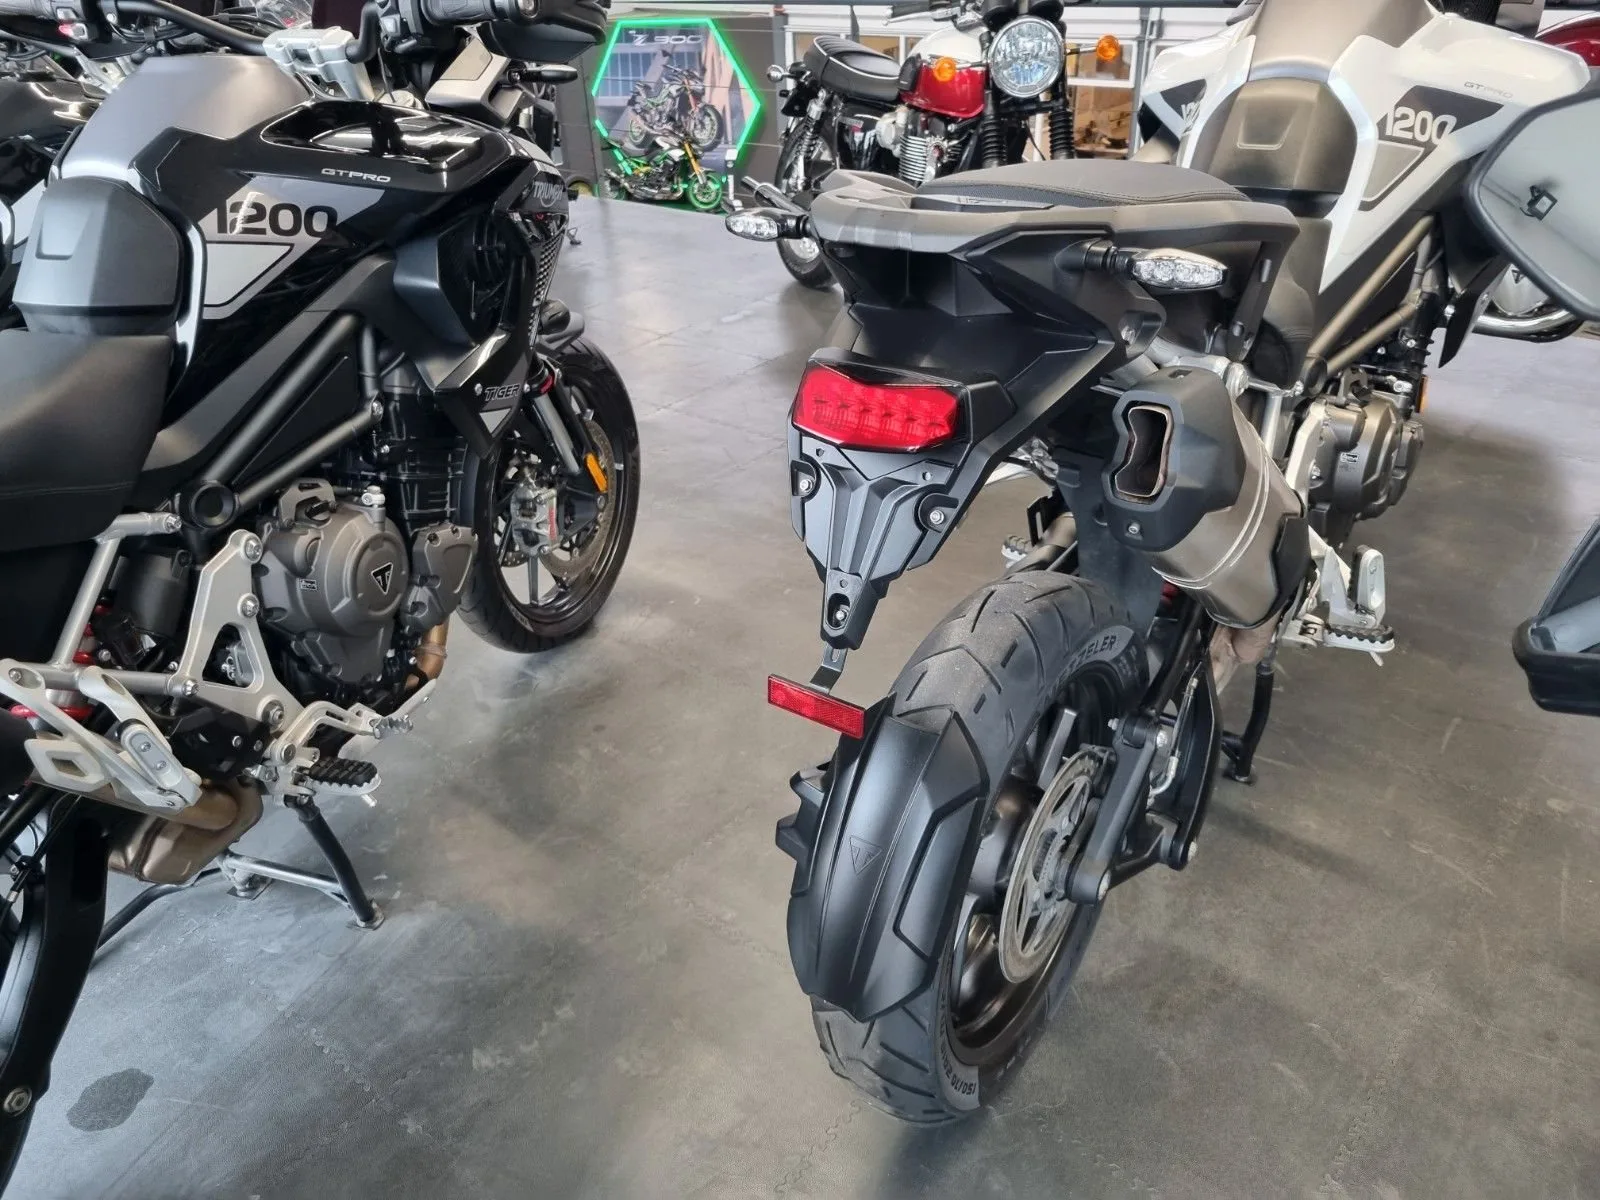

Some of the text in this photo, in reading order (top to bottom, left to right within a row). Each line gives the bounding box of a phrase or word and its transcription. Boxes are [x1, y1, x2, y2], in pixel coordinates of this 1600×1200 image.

[1385, 106, 1457, 145] 1200
[216, 201, 338, 238] 1200
[484, 383, 520, 401] TIGER
